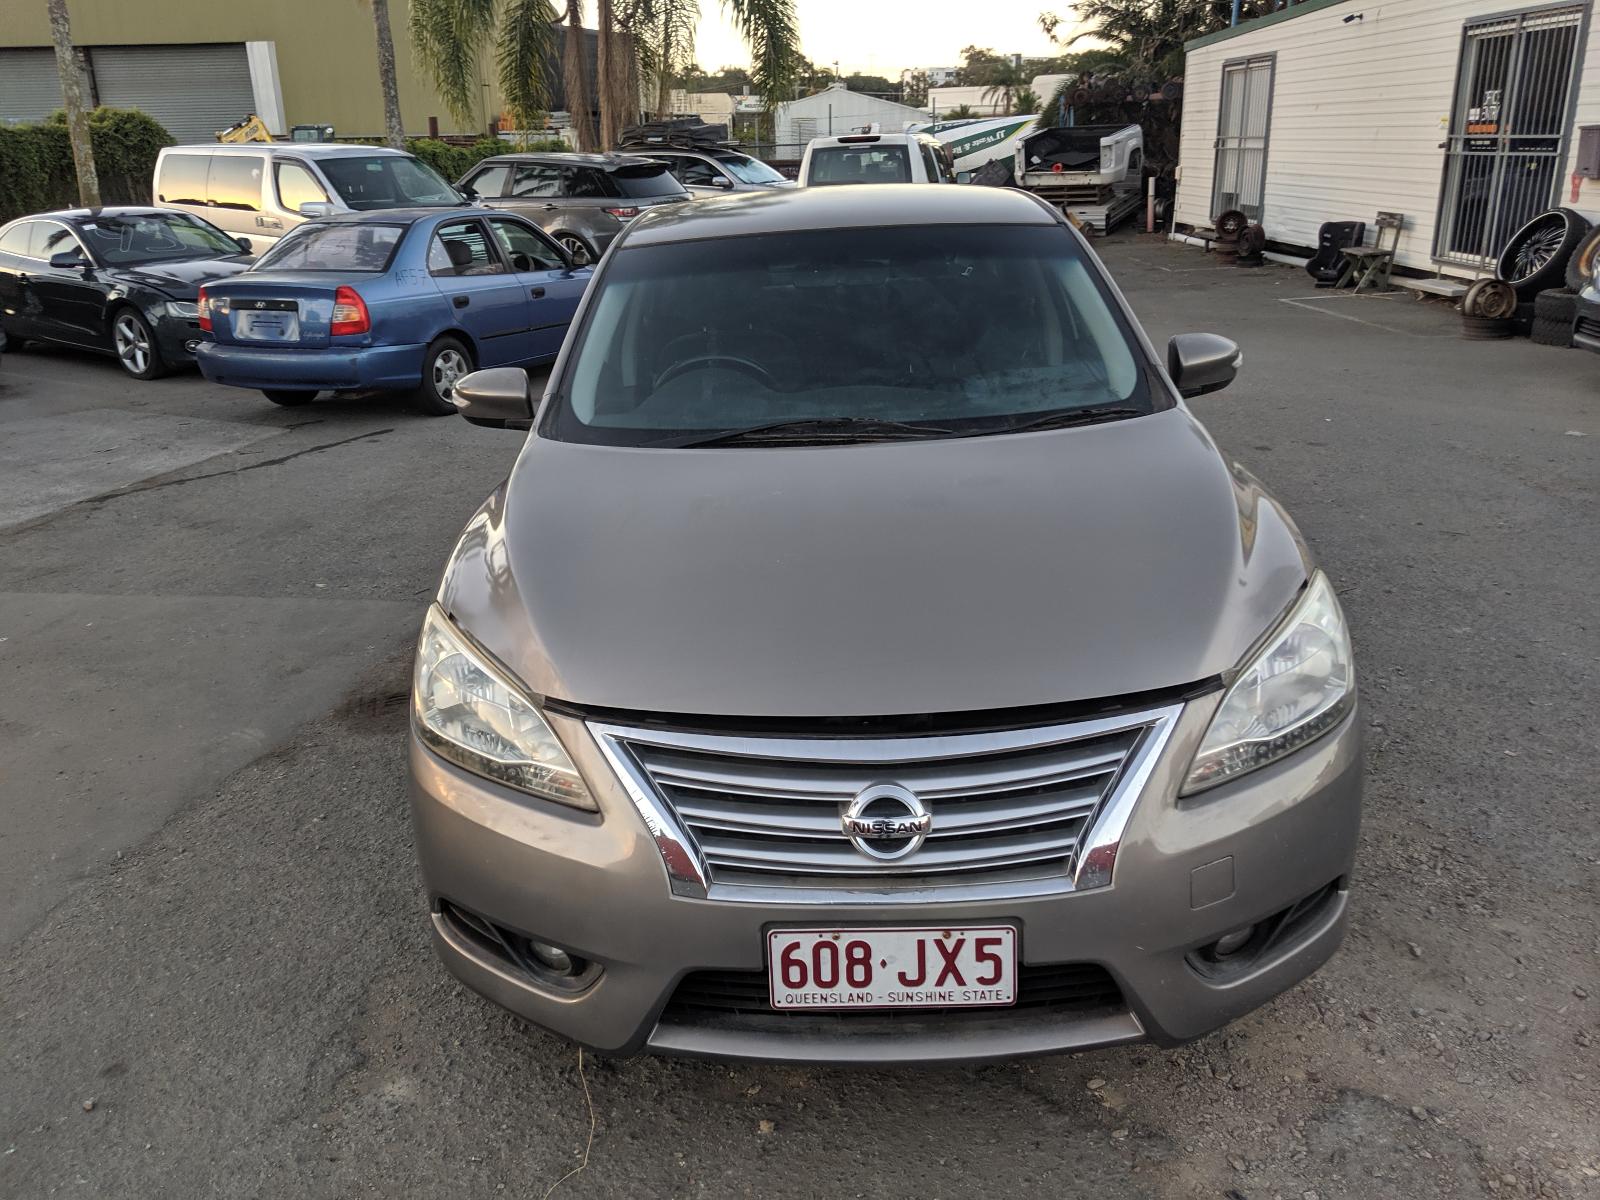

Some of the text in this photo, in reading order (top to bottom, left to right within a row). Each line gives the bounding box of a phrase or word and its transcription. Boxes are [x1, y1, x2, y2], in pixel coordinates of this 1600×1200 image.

[852, 821, 922, 834] NISSAN
[780, 937, 1003, 989] 608 JX5
[785, 993, 874, 1005] QUEENSLAND
[887, 990, 955, 1003] SUNSHINE
[962, 989, 1003, 1001] STATE
